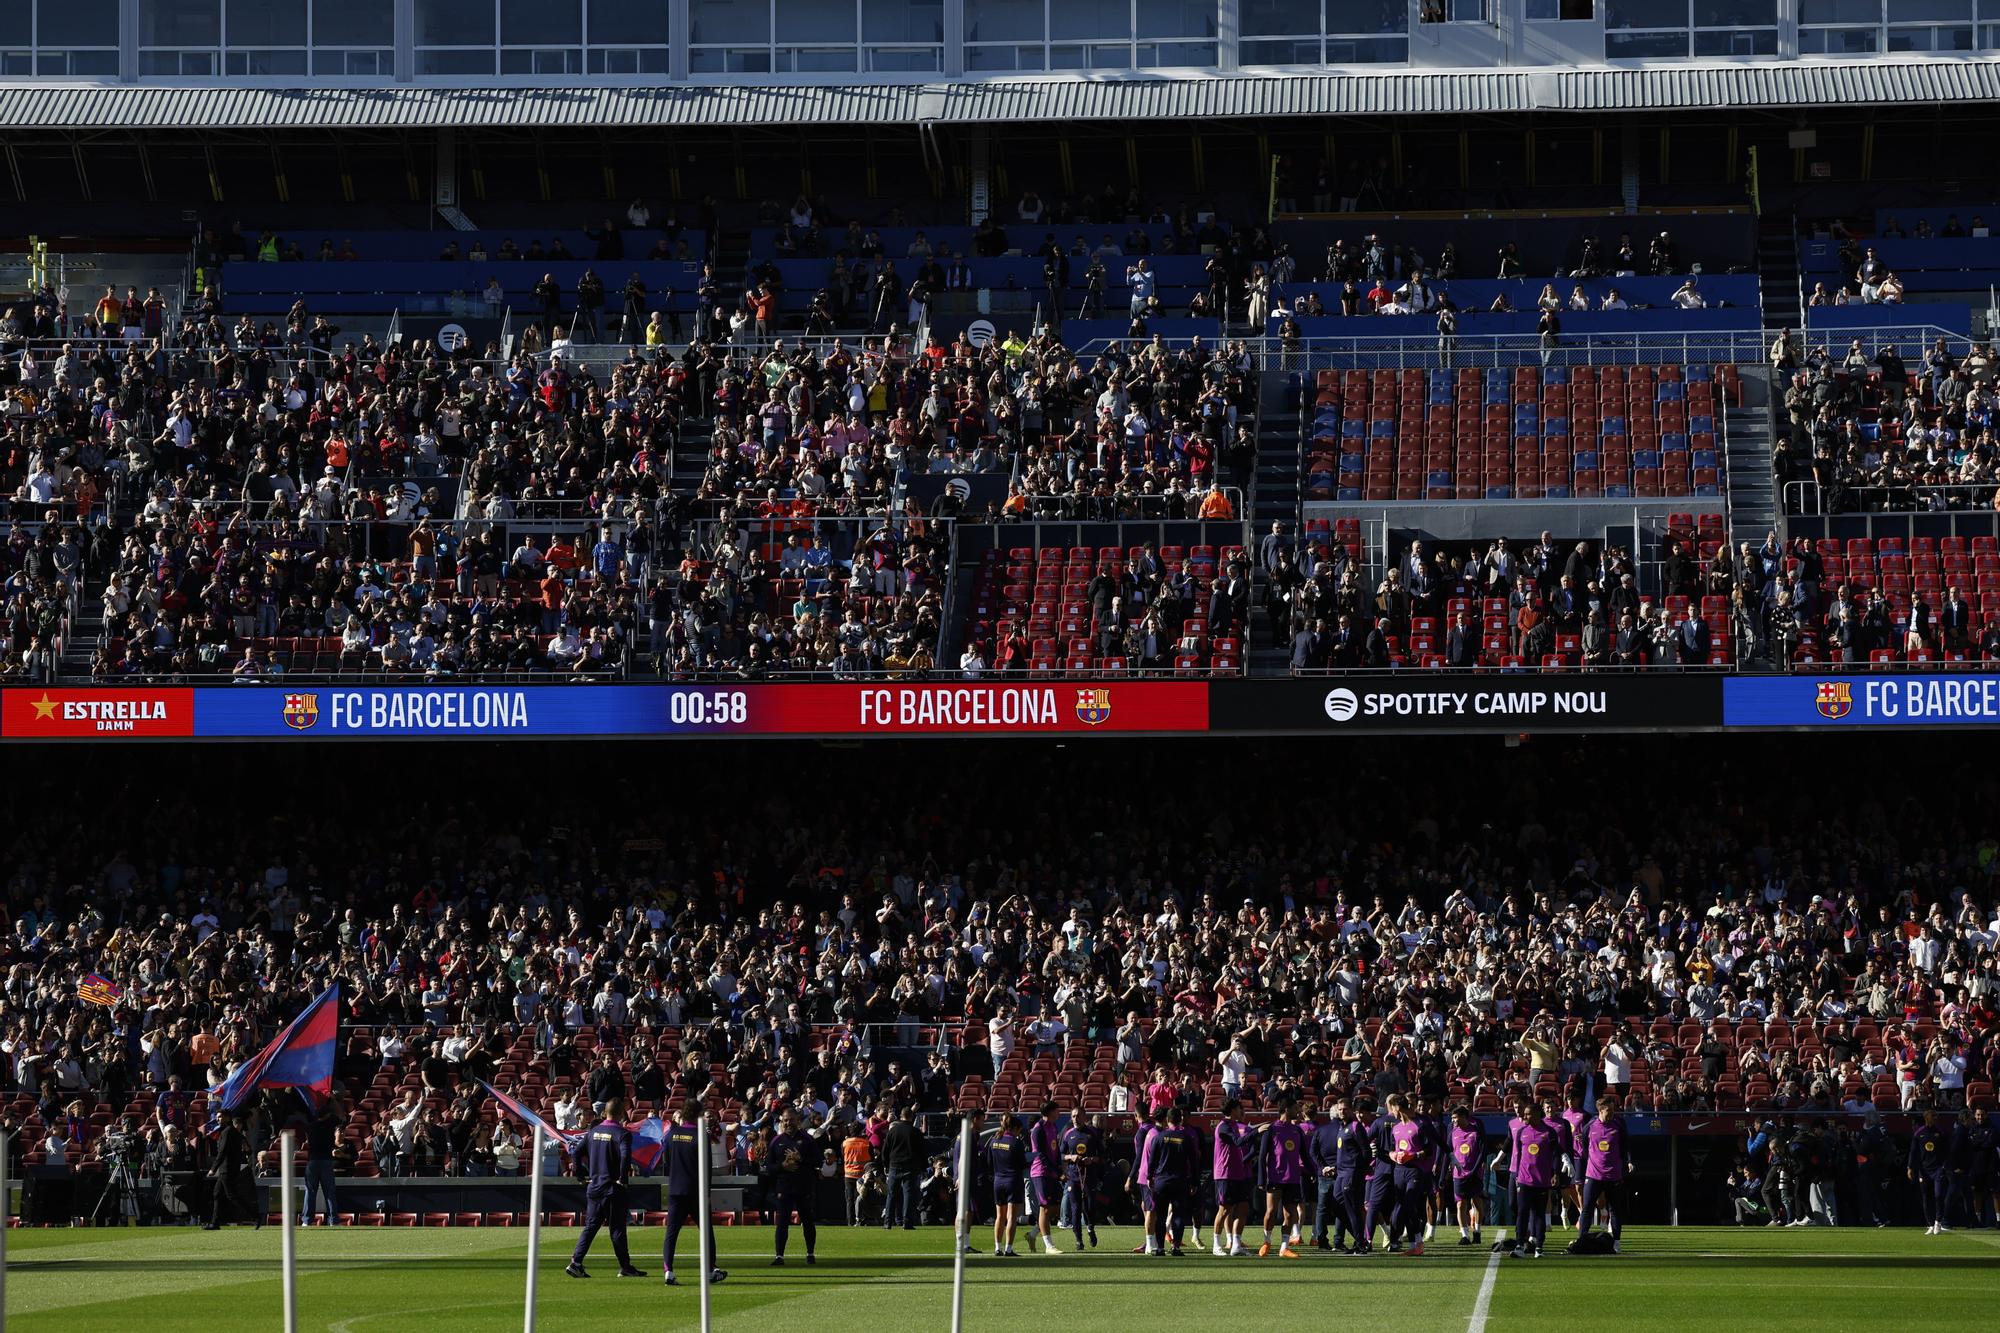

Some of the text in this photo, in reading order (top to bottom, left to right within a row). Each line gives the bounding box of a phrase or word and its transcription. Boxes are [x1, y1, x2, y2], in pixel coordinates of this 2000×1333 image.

[63, 701, 167, 720] ESTRELLA
[331, 692, 528, 728] FC BARCELONA
[670, 691, 747, 724] 00:58
[860, 688, 1058, 725] FC BARCELONA
[1363, 691, 1606, 715] SPOTIFY CAMP NOU
[1866, 679, 2000, 717] FC BARCE
[96, 721, 134, 731] DAMM
